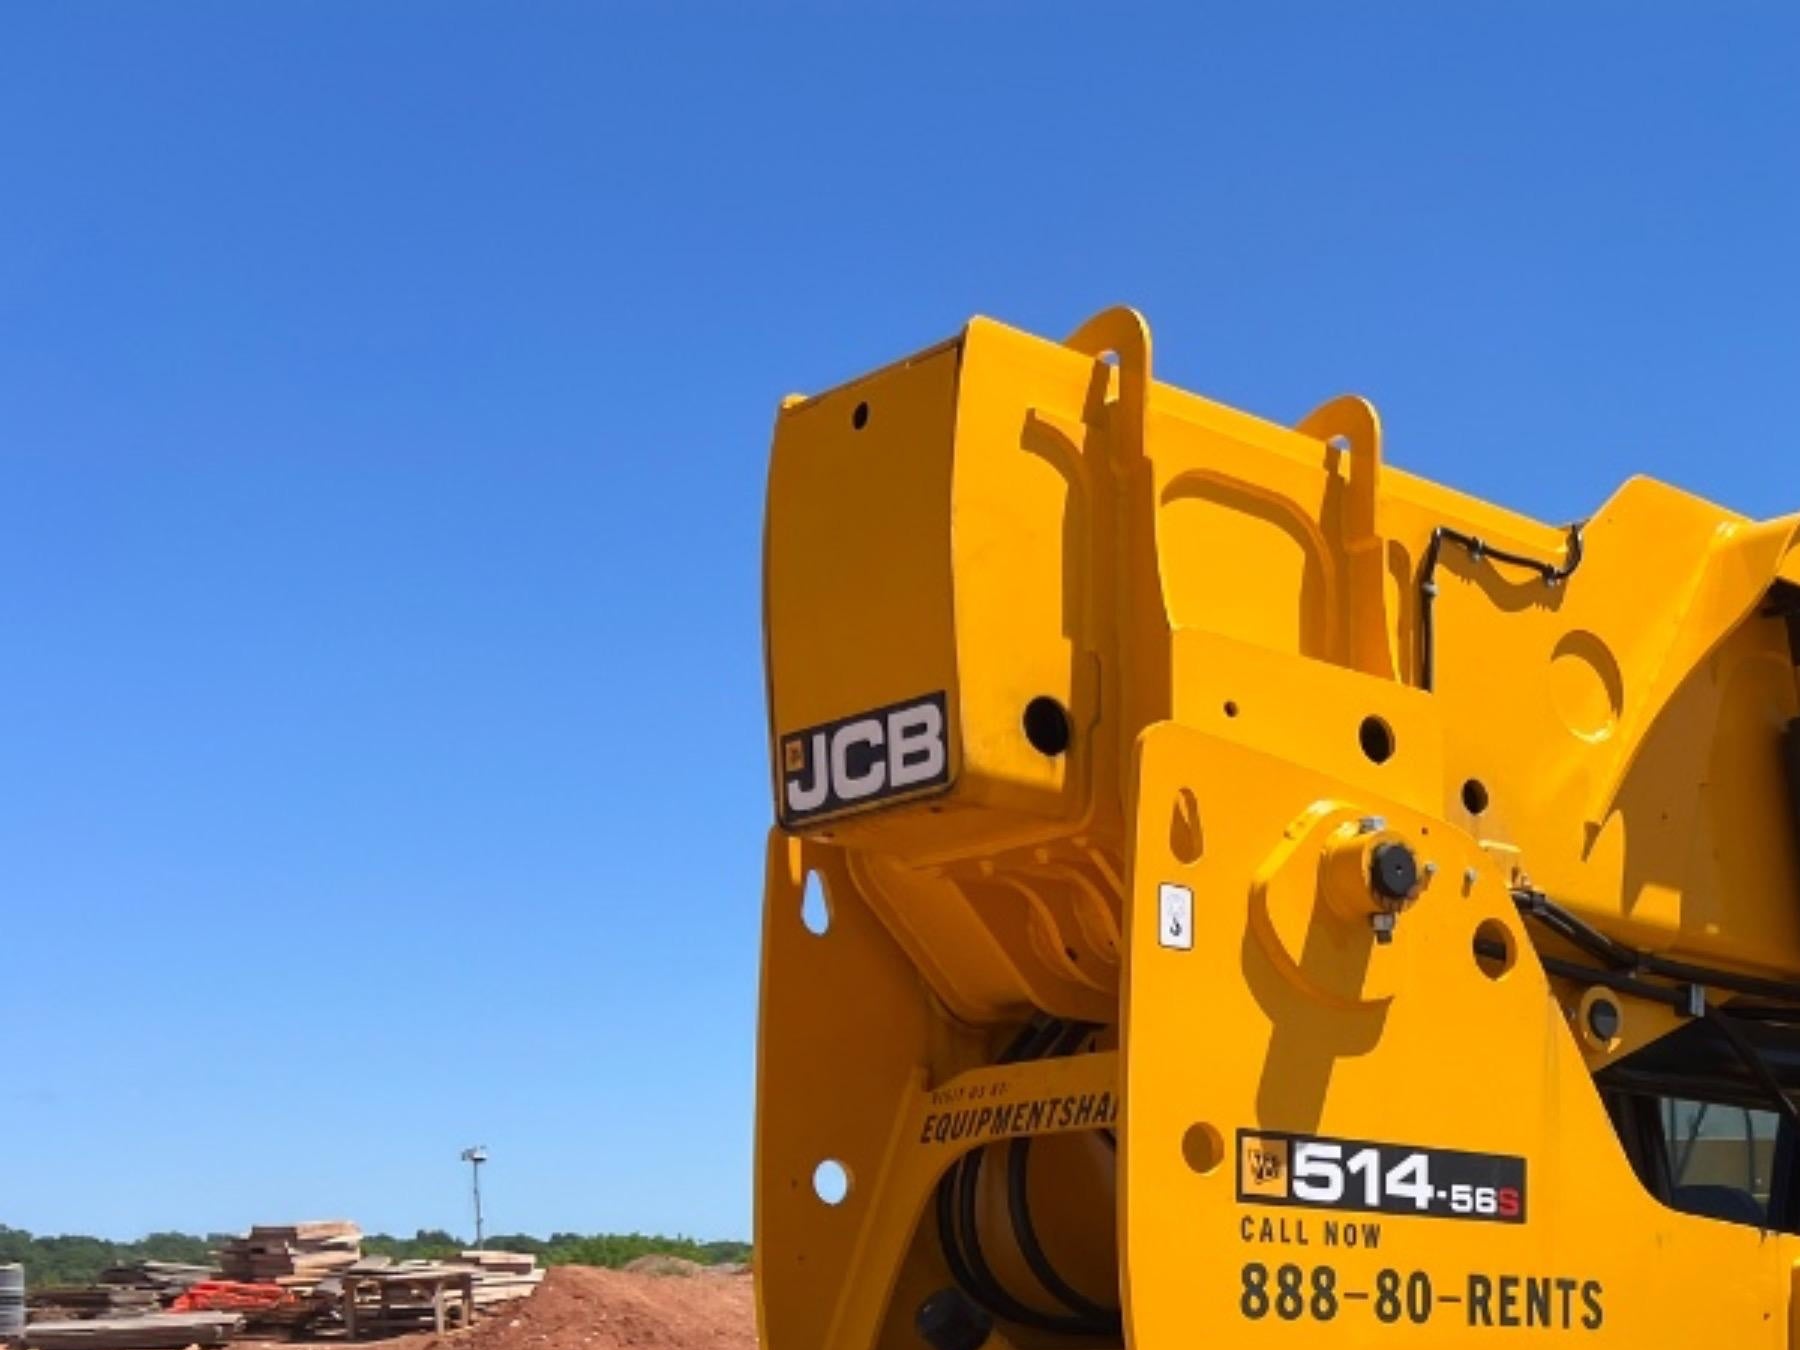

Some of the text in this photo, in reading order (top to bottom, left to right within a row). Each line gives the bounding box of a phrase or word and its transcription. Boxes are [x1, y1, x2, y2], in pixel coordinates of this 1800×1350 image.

[787, 703, 945, 811] JCB
[1241, 1215, 1381, 1249] CALL NOW
[1239, 1262, 1604, 1331] 888-80-RENTS
